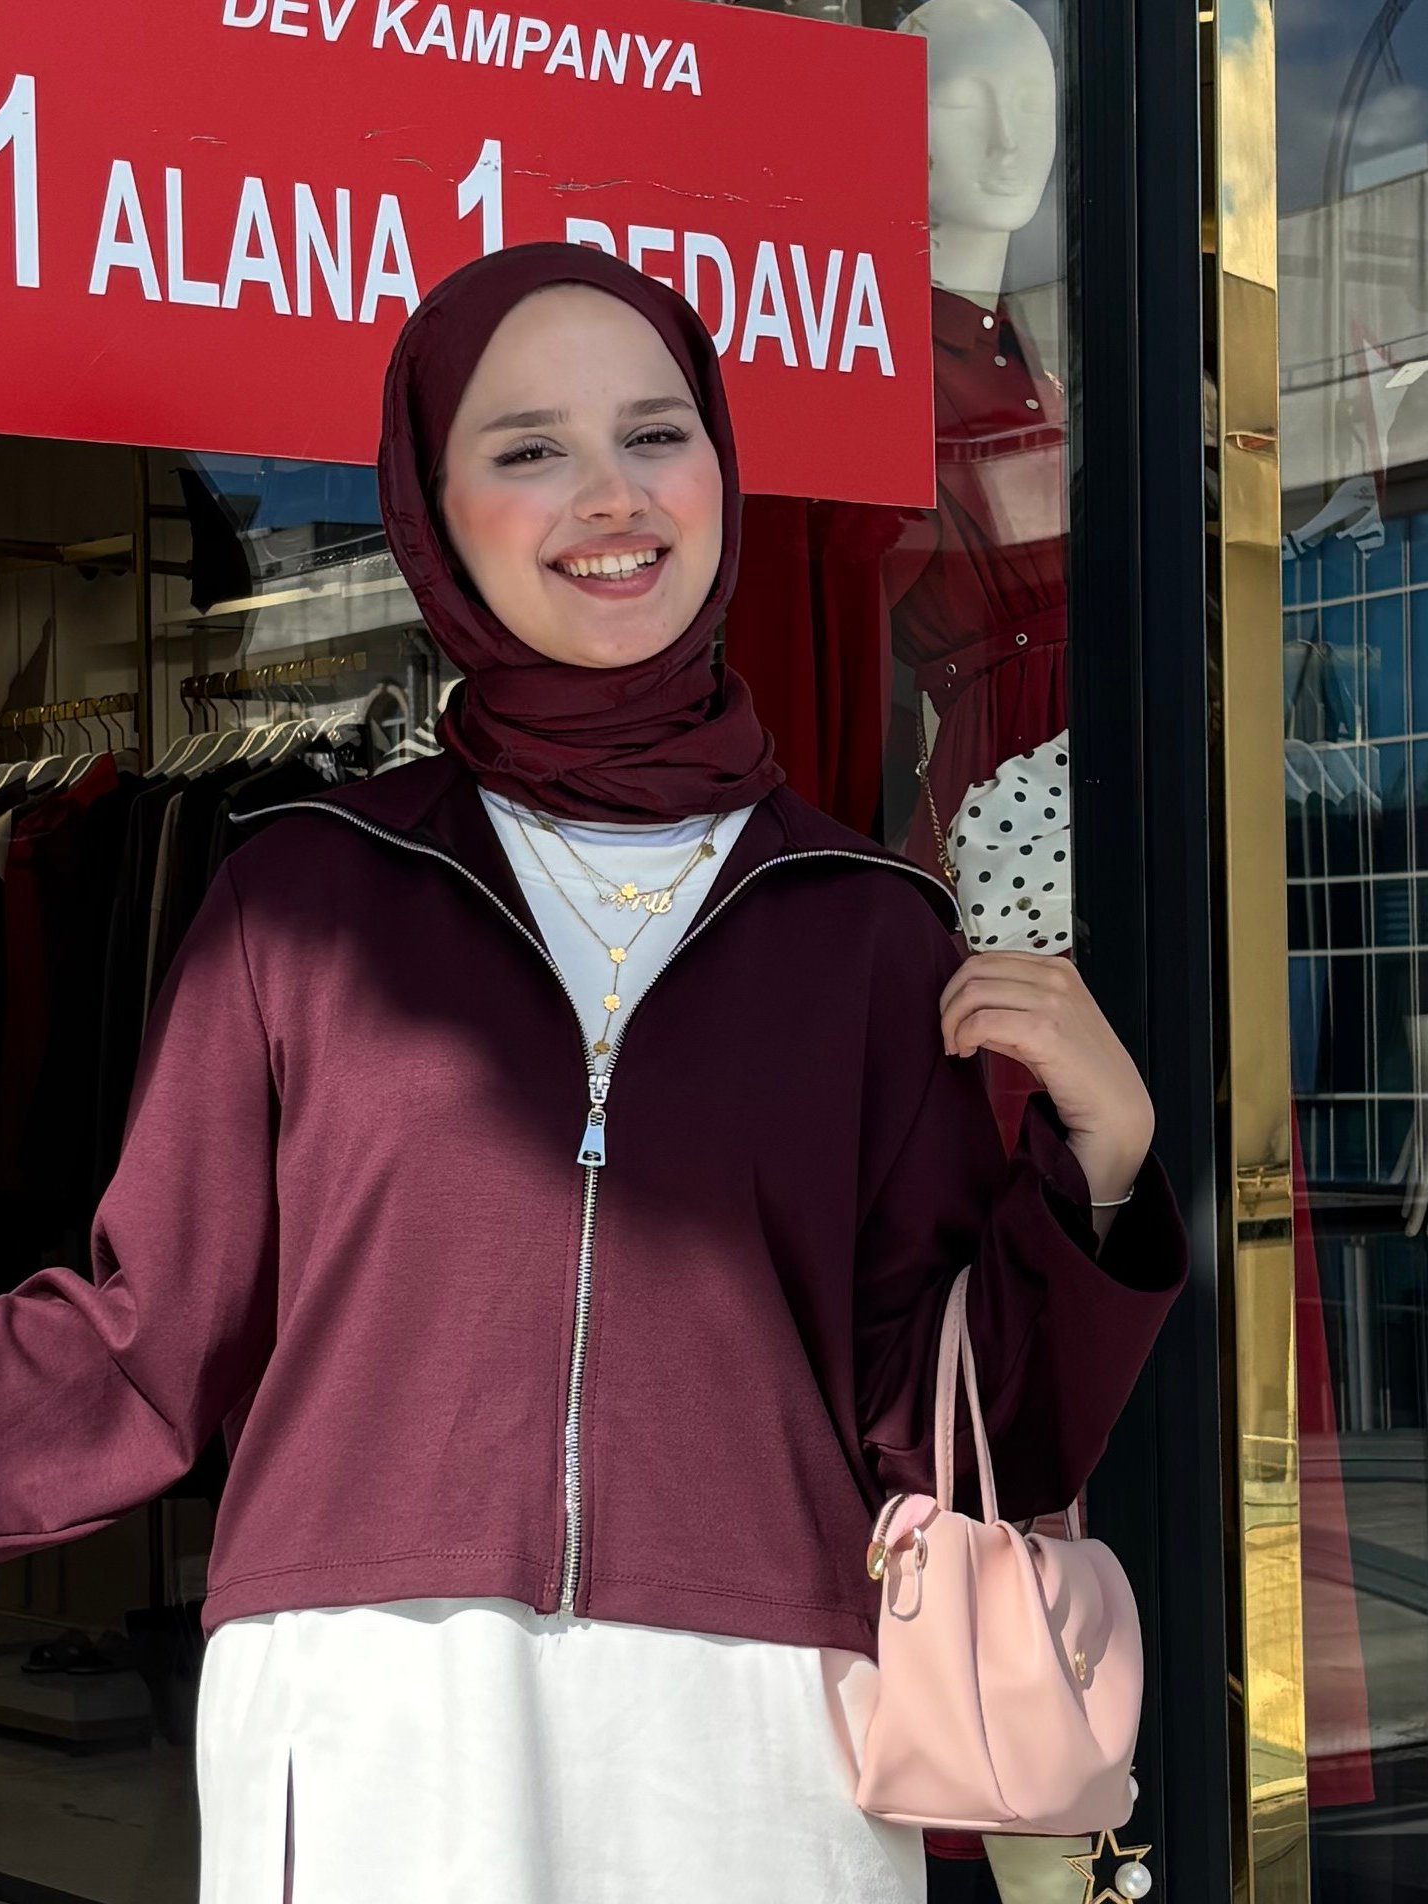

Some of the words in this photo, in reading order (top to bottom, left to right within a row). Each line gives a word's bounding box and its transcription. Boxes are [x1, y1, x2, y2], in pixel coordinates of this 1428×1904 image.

[89, 159, 420, 324] ALANA
[457, 138, 504, 257] 1
[565, 217, 896, 377] DAVA
